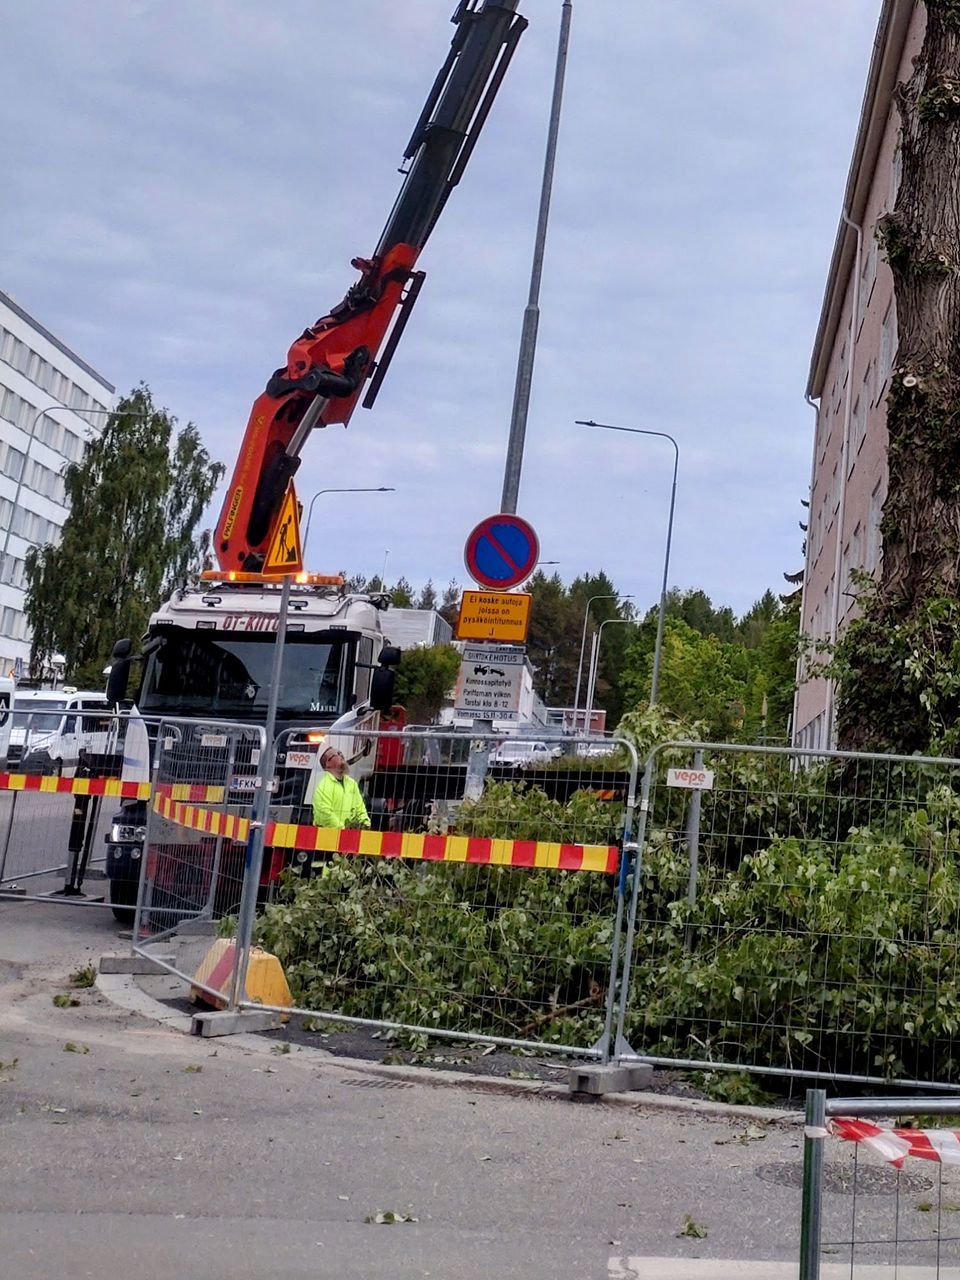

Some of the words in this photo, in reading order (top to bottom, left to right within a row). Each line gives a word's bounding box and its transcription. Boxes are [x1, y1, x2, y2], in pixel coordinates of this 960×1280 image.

[223, 487, 243, 538] PALFINGER
[470, 595, 477, 603] Ei
[479, 596, 500, 605] koske
[501, 598, 522, 607] autoja
[478, 607, 500, 615] joissa
[467, 652, 517, 662] SIIRTOKEHOTUS
[482, 699, 492, 708] klo
[289, 752, 311, 766] vepe
[674, 770, 706, 785] vepe
